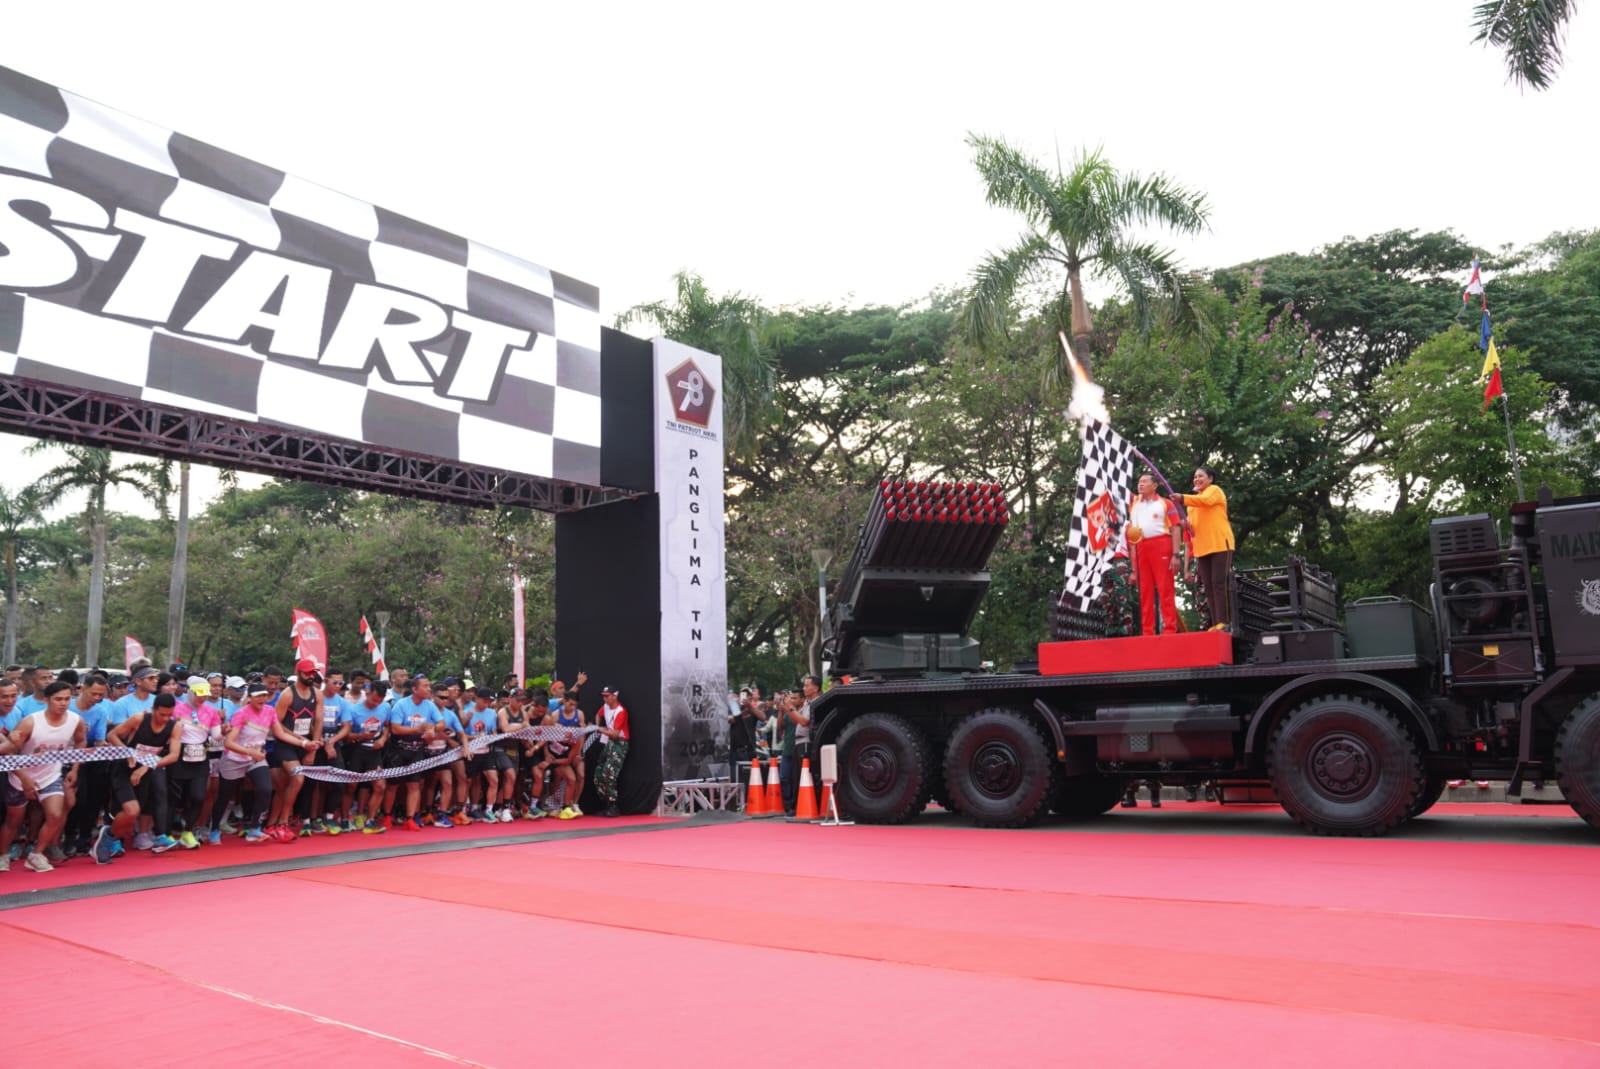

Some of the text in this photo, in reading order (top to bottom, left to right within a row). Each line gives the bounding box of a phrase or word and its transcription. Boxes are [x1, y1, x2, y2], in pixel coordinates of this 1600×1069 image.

[0, 169, 537, 403] START
[677, 370, 704, 412] 78
[678, 423, 702, 434] PATRIOT
[689, 449, 701, 586] PANGLIMA
[691, 610, 702, 659] TNI
